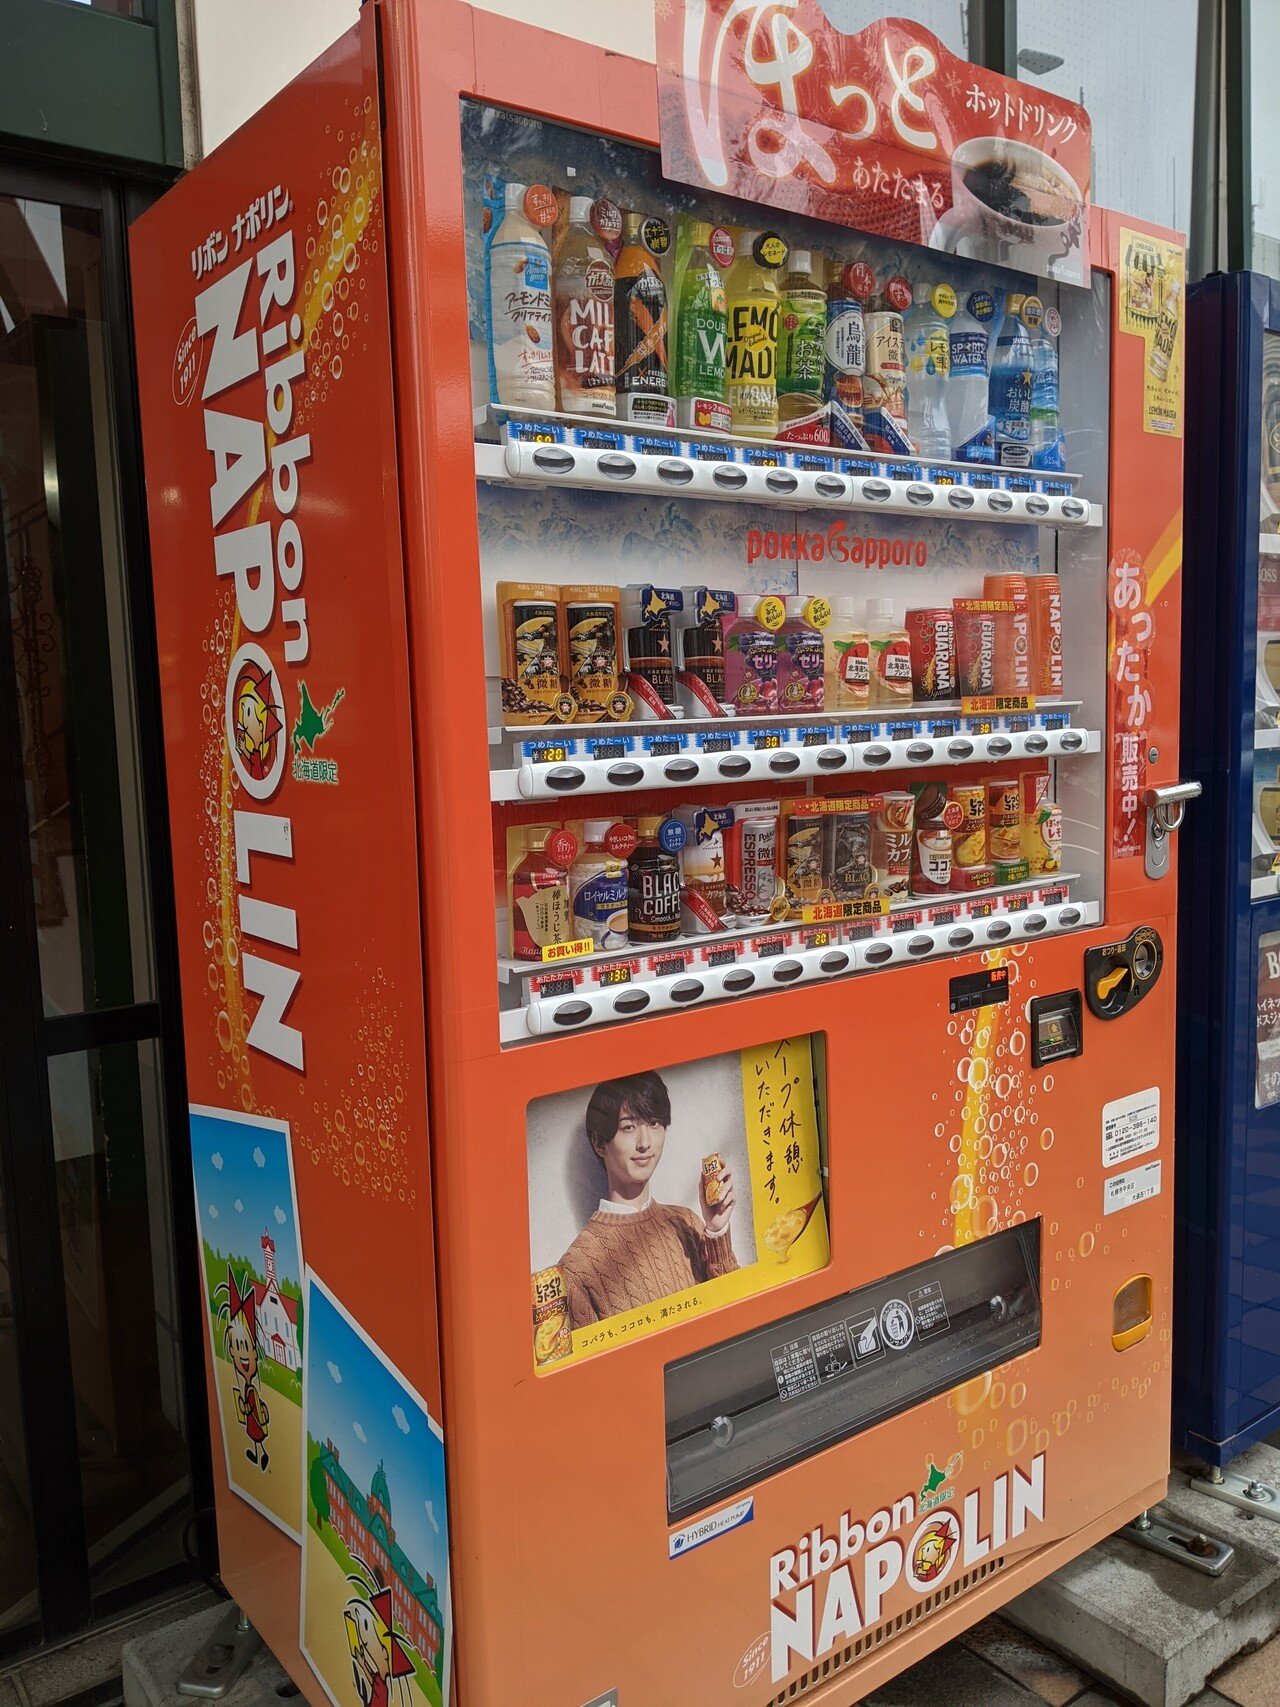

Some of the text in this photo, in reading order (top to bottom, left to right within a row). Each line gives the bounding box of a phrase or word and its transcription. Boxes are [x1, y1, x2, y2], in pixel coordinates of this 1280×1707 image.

[965, 83, 1079, 145] ホットドリンク
[852, 156, 945, 210] あたたまる
[191, 183, 290, 281] リボン ナポリン
[795, 340, 815, 381] お茶
[952, 354, 982, 365] WATER
[179, 351, 196, 395] 1911
[1009, 399, 1030, 413] 炭酸
[515, 422, 560, 435] つめた～い
[580, 430, 621, 441] つめた～い
[256, 228, 310, 663] Ribbon
[638, 437, 677, 448] つめた～い
[693, 443, 731, 454] つめた～い
[748, 449, 783, 459] つめた～い
[747, 520, 927, 569] pokka sapporo
[1049, 594, 1062, 687] NAPOLIN
[1114, 561, 1152, 728] あったか
[935, 620, 950, 690] GUARANA
[981, 620, 993, 688] GUARANA
[194, 259, 304, 1072] NAPOLIN
[970, 697, 1028, 711] 北海道限定商品
[701, 731, 736, 740] つめた～い
[752, 728, 786, 737] つめた～い
[801, 726, 832, 735] つめた～い
[846, 724, 877, 732] つめた～い
[529, 740, 572, 750] つめた～い
[591, 737, 630, 746] つめた～い
[648, 734, 685, 743] つめた～い
[291, 759, 339, 784] 北海道限定
[810, 800, 869, 813] 北海道限定商品
[744, 833, 757, 901] ESPRESSO
[813, 900, 881, 921] 北海道限定商品
[754, 934, 789, 945] あたたか～い
[547, 943, 592, 959] お買い得!!
[705, 942, 742, 954] あたたか～い
[652, 952, 690, 963] あたたか～い
[597, 961, 636, 973] あたたか～い
[536, 971, 578, 984] あたたか～い
[755, 1061, 781, 1205] いただきます。
[537, 1287, 563, 1304] コトコト
[686, 1520, 718, 1543] HYBRID
[769, 1492, 917, 1602] Ribbon
[771, 1451, 1046, 1685] NAPOLIN
[742, 1635, 769, 1669] Since
[744, 1650, 766, 1681] 1911
